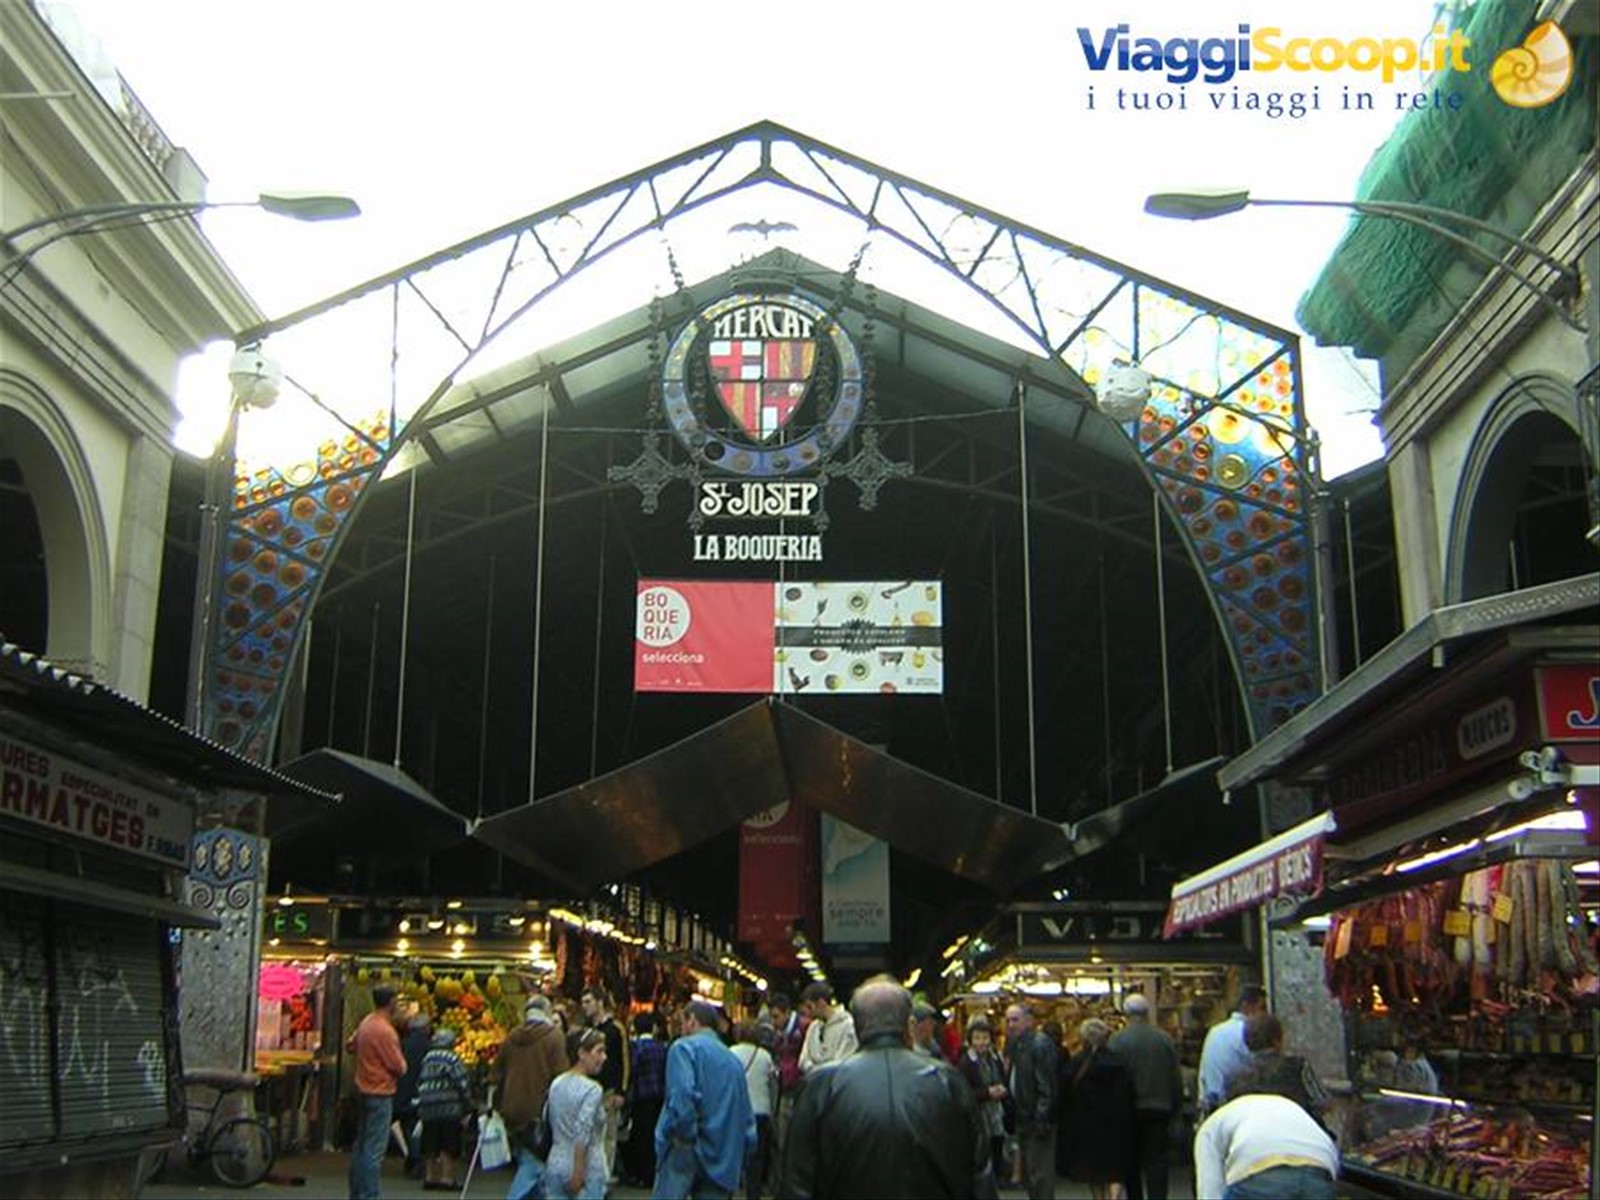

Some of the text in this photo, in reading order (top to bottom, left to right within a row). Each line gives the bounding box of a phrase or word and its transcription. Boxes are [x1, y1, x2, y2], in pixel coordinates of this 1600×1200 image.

[714, 305, 815, 338] MERCAT
[727, 482, 818, 516] JOSEP
[693, 534, 822, 561] LA BOQUERIA
[644, 592, 668, 607] BO
[643, 609, 680, 624] QUE
[643, 625, 673, 640] RIA
[641, 651, 704, 664] selecciona
[1, 770, 145, 849] RMATGES
